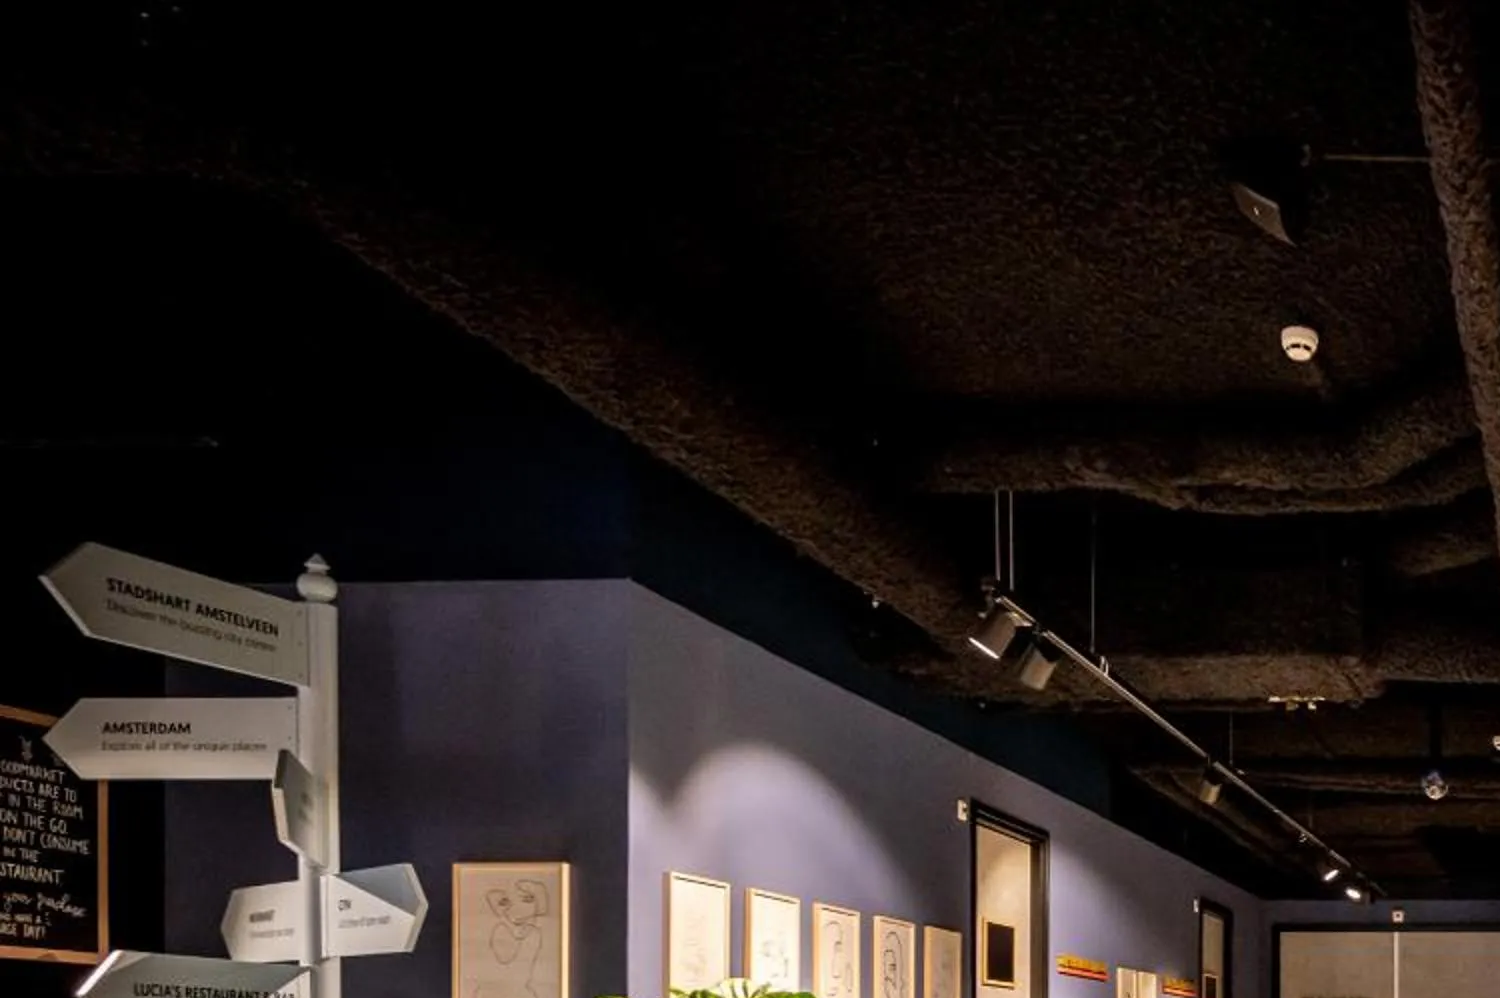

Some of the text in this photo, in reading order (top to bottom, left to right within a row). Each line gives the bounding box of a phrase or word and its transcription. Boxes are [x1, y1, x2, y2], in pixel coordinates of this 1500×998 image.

[106, 577, 279, 637] STADSHART AMSTELVEEN
[102, 722, 191, 734] AMSTERDAM
[38, 783, 61, 799] ARE
[64, 788, 77, 803] TO
[26, 795, 47, 813] THE
[22, 811, 46, 831] THE
[40, 831, 90, 855] CONSUME
[133, 982, 182, 998] LUCIA'S
